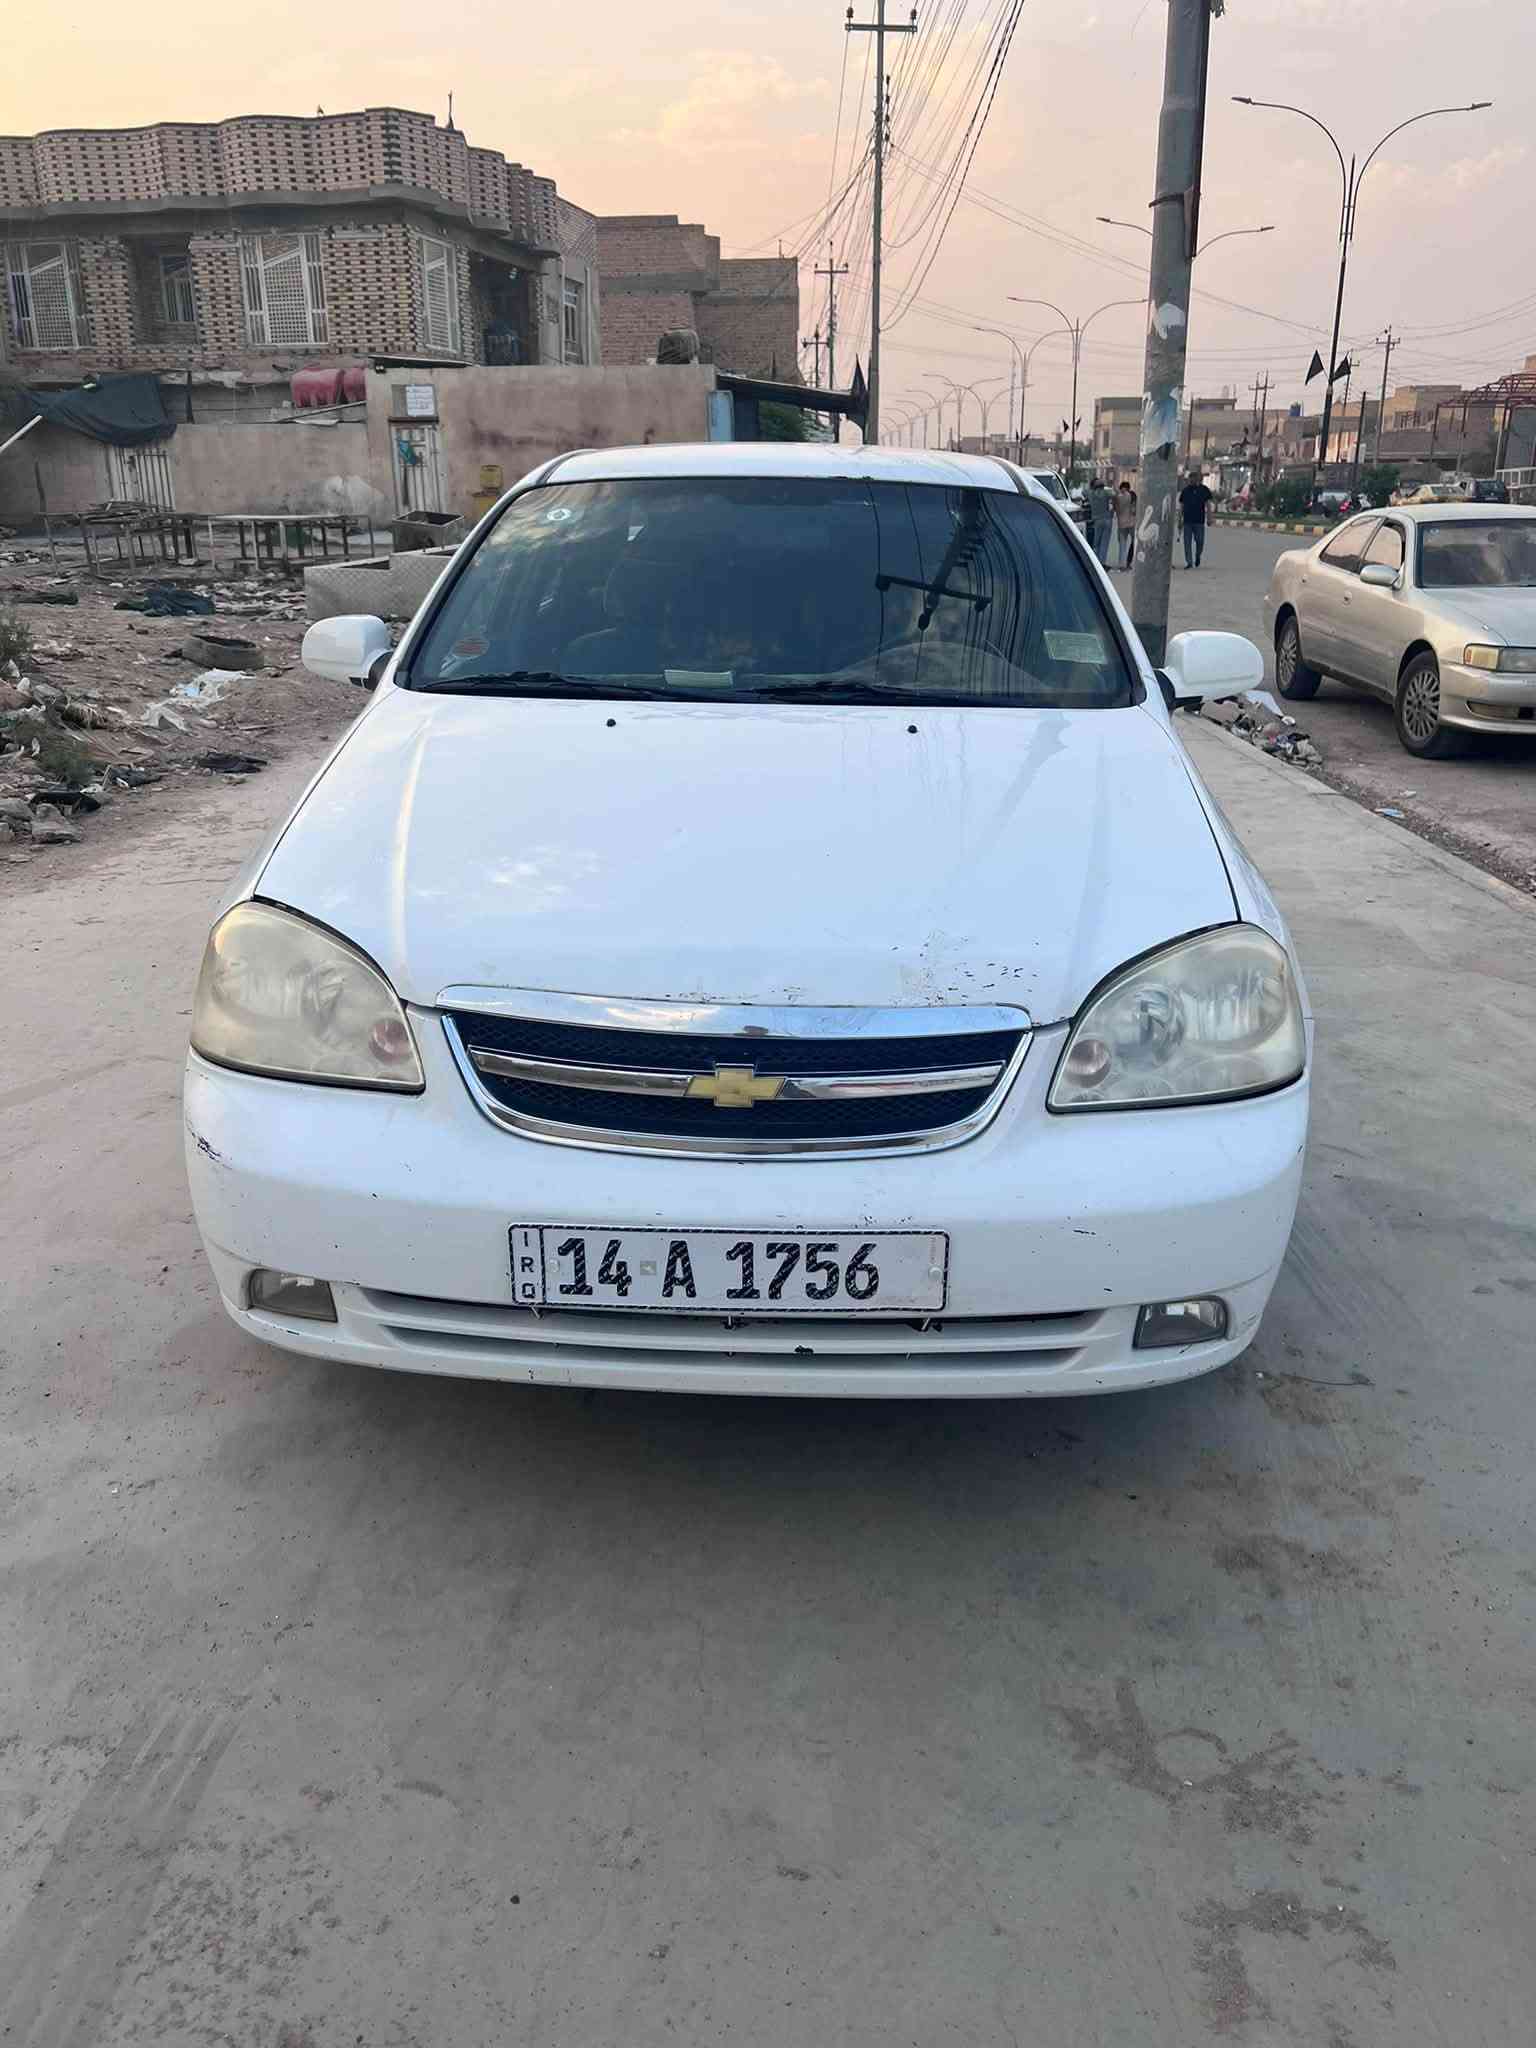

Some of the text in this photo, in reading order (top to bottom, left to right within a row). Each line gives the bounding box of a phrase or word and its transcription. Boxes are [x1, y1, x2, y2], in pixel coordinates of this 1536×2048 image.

[520, 1231, 536, 1299] IRQ
[557, 1237, 632, 1297] 14
[662, 1240, 697, 1298] A
[726, 1241, 880, 1300] 1756
